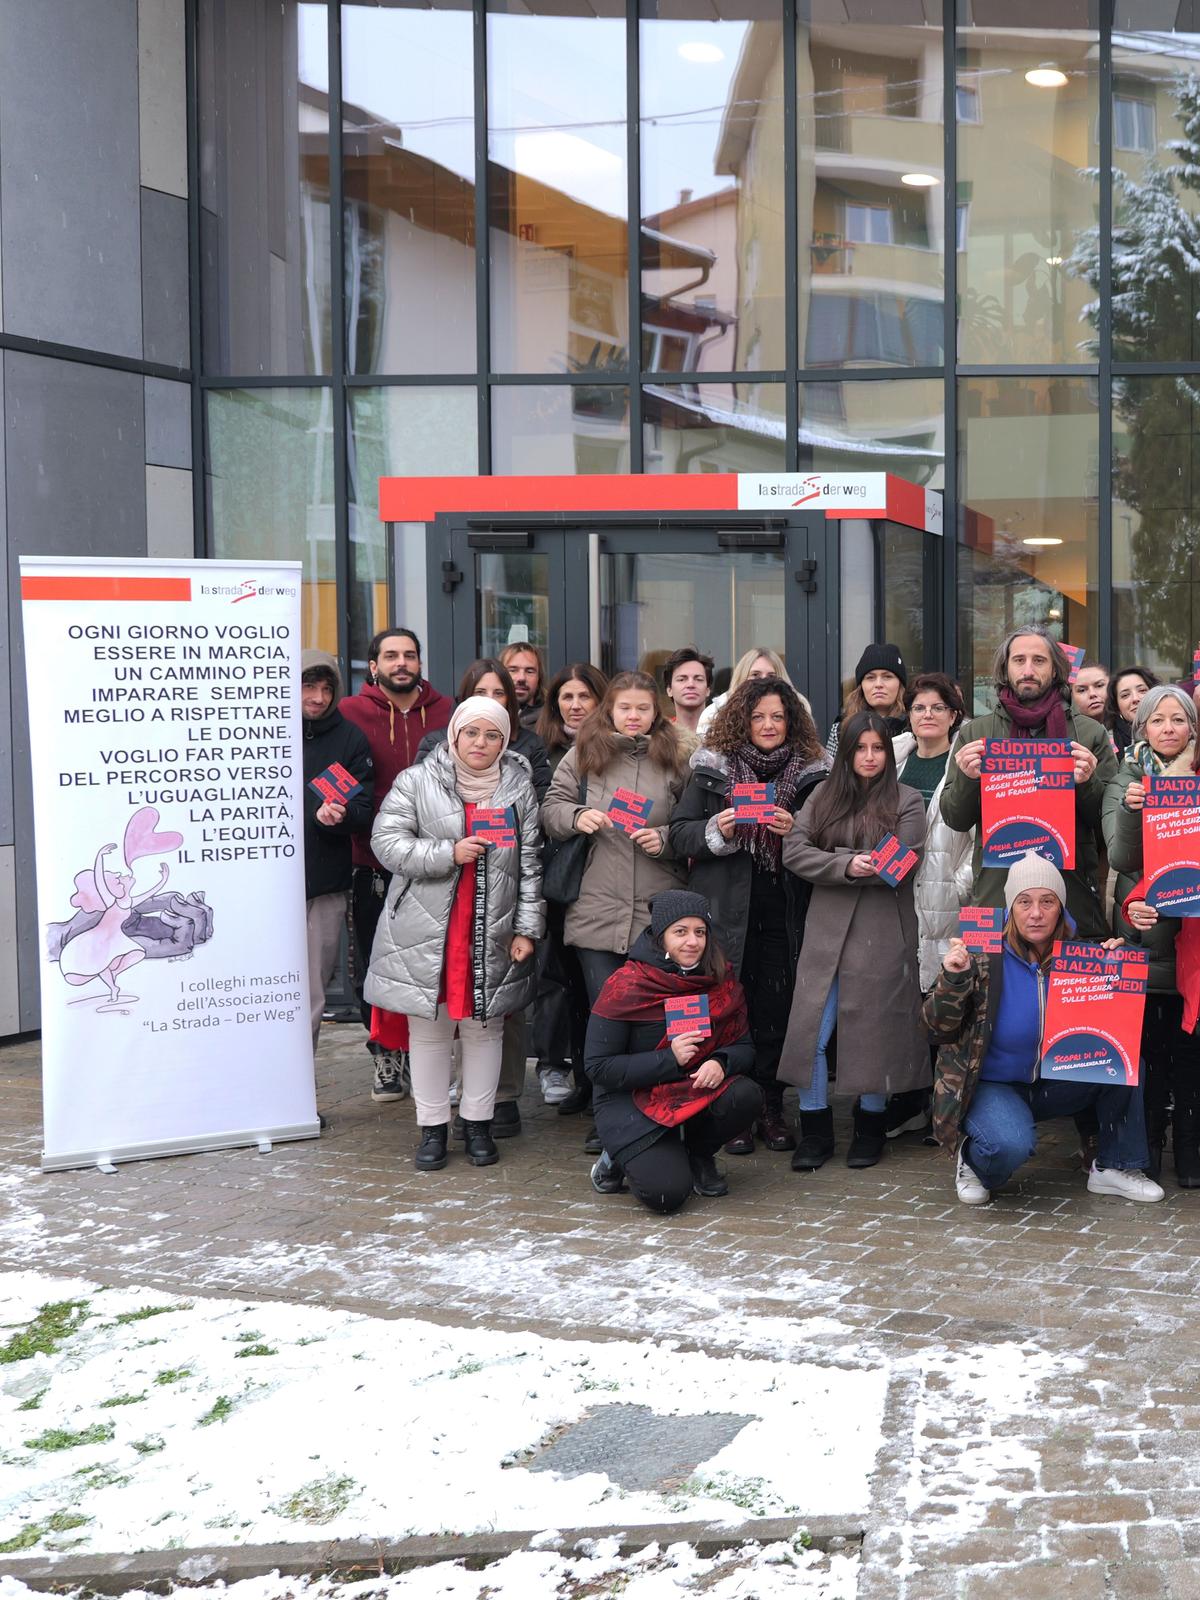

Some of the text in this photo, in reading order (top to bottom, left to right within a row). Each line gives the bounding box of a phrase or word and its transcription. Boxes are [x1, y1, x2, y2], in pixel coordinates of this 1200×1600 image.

[759, 483, 867, 498] la strada der weg
[201, 584, 296, 597] la strada der weg
[69, 626, 289, 639] OGNI GIORNO VOGLIO
[94, 646, 289, 661] ESSERE IN MARCIA,
[115, 666, 290, 680] UN CAMMINO PER
[93, 686, 290, 702] IMPARARE SEMPRE
[65, 706, 291, 723] MEGLIO A RISPETTARE
[189, 726, 291, 741] LE DONNE.
[100, 746, 291, 764] VOGLIO FAR PARTE
[990, 740, 1070, 756] SÜDTIROL
[985, 757, 1037, 771] STEHT
[60, 766, 292, 786] DEL PERCORSO VERSO
[1039, 774, 1071, 787] AUF
[1145, 795, 1159, 806] SI
[1160, 794, 1195, 806] ALZA
[190, 802, 293, 822] LA PARITÀ,
[179, 844, 295, 863] IL RISPETTO
[1107, 948, 1145, 962] ADIGE
[1054, 959, 1118, 975] SI ALZA IN
[181, 971, 300, 992] I colleghi maschi
[1111, 980, 1143, 993] PIEDI
[172, 1015, 220, 1030] Strada
[237, 1012, 261, 1023] Der
